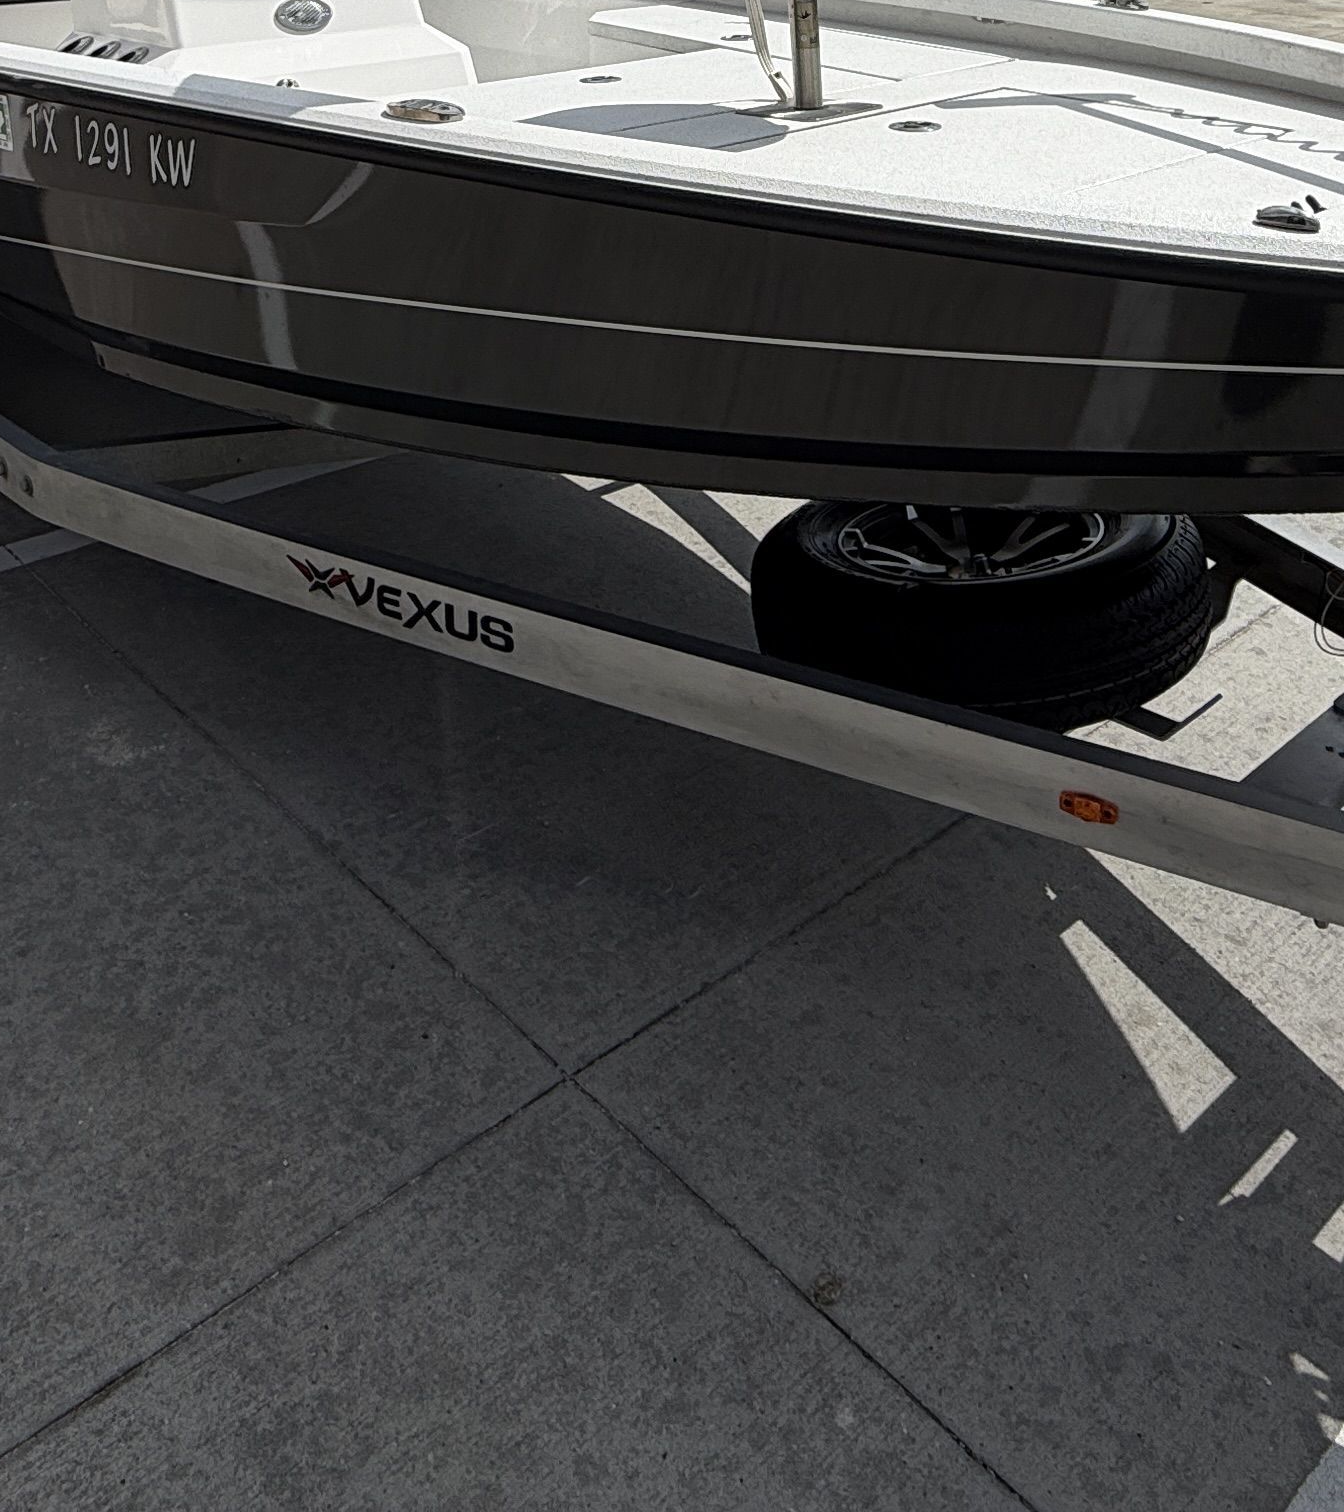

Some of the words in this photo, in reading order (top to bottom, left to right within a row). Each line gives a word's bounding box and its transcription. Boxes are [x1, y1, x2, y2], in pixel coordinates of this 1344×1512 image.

[26, 102, 58, 154] TX
[74, 115, 132, 176] 1291
[149, 133, 196, 187] KW
[338, 567, 515, 654] VEXUS
